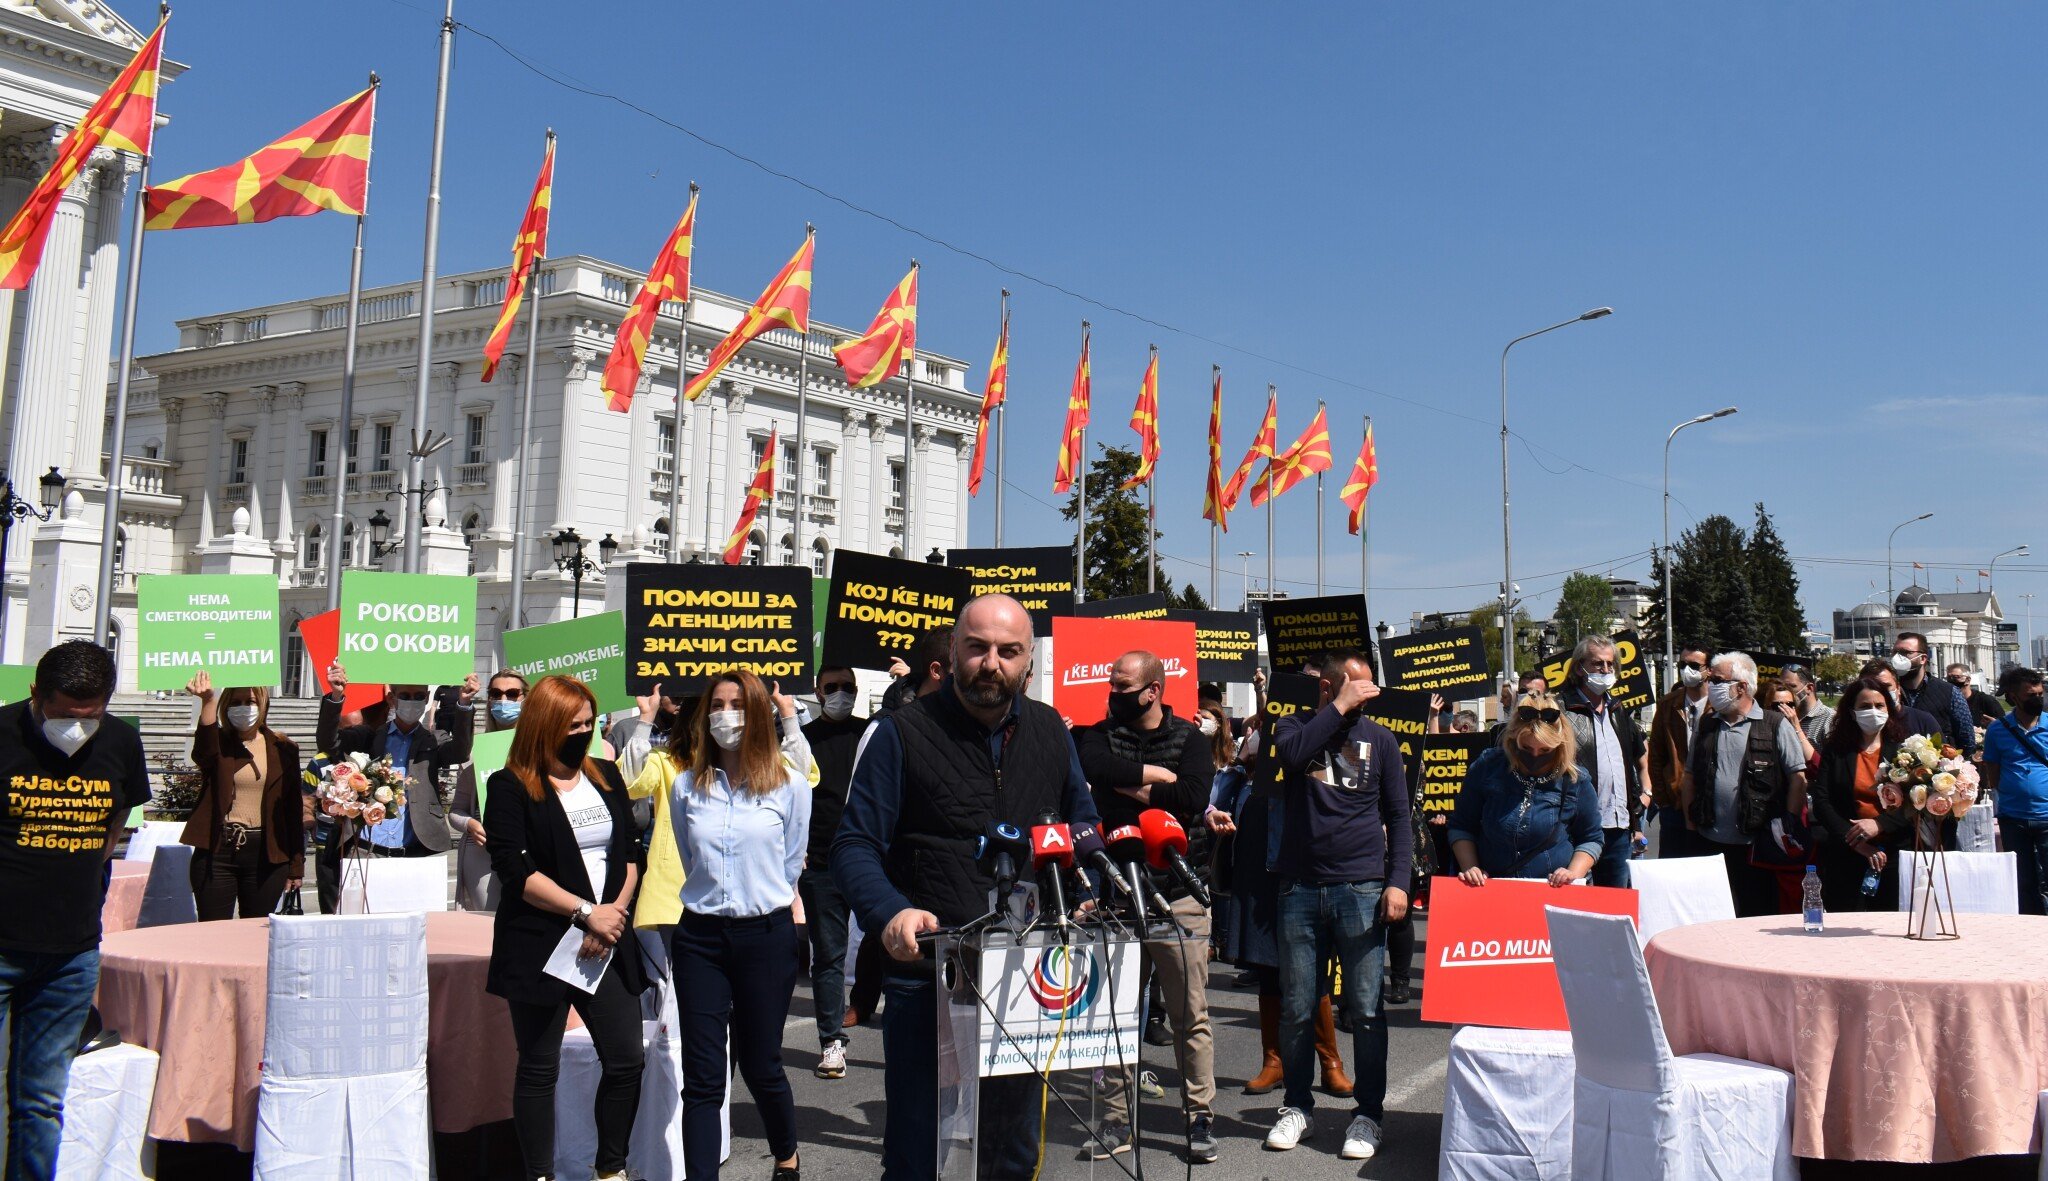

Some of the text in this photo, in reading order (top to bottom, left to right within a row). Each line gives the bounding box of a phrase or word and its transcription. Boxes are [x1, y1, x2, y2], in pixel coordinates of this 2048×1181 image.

[955, 565, 1037, 580] ЈасСум
[845, 581, 954, 612] КОЈ ЌЕ НИ
[970, 581, 1072, 597] ристички
[189, 594, 230, 605] НЕМА
[643, 589, 798, 608] ПОМОШ ЗА
[145, 610, 272, 622] СМЕТКОВОДИТЕЛИ
[358, 602, 459, 623] РОКОВИ
[1273, 612, 1360, 626] ПОМОШ ЗА
[648, 613, 792, 631] АГЕНЦИИТЕ
[1234, 631, 1251, 640] ГО
[1278, 624, 1359, 638] АГЕНЦИИТЕ
[344, 632, 470, 653] КО ОКОВИ
[643, 638, 726, 653] ЗНАЧИ
[731, 638, 798, 653] СПАС
[876, 630, 915, 650] ???
[1277, 638, 1363, 653] ЗНАЧИ СПАС
[1393, 640, 1455, 658] ДРЖАВАТА
[145, 649, 273, 667] НЕМА ПЛАТИ
[548, 644, 624, 670] МОЖЕМЕ,
[1275, 656, 1295, 667] ЗА
[1413, 652, 1456, 666] ЗАГУБИ
[636, 661, 671, 676] ЗА
[1071, 663, 1089, 678] ЌЕ
[1401, 662, 1471, 680] МИЛИОНСКИ
[1421, 680, 1440, 689] ОД
[1440, 672, 1488, 688] ДАНОЦИ
[1608, 684, 1630, 697] EN
[8, 793, 113, 809] Туристички
[1422, 798, 1455, 811] ANI
[1452, 941, 1466, 958] A
[1470, 940, 1501, 958] DO
[1000, 1033, 1033, 1046] СОЈУЗ
[1036, 1032, 1052, 1043] НА
[984, 1051, 1037, 1066] КОМОРИ
